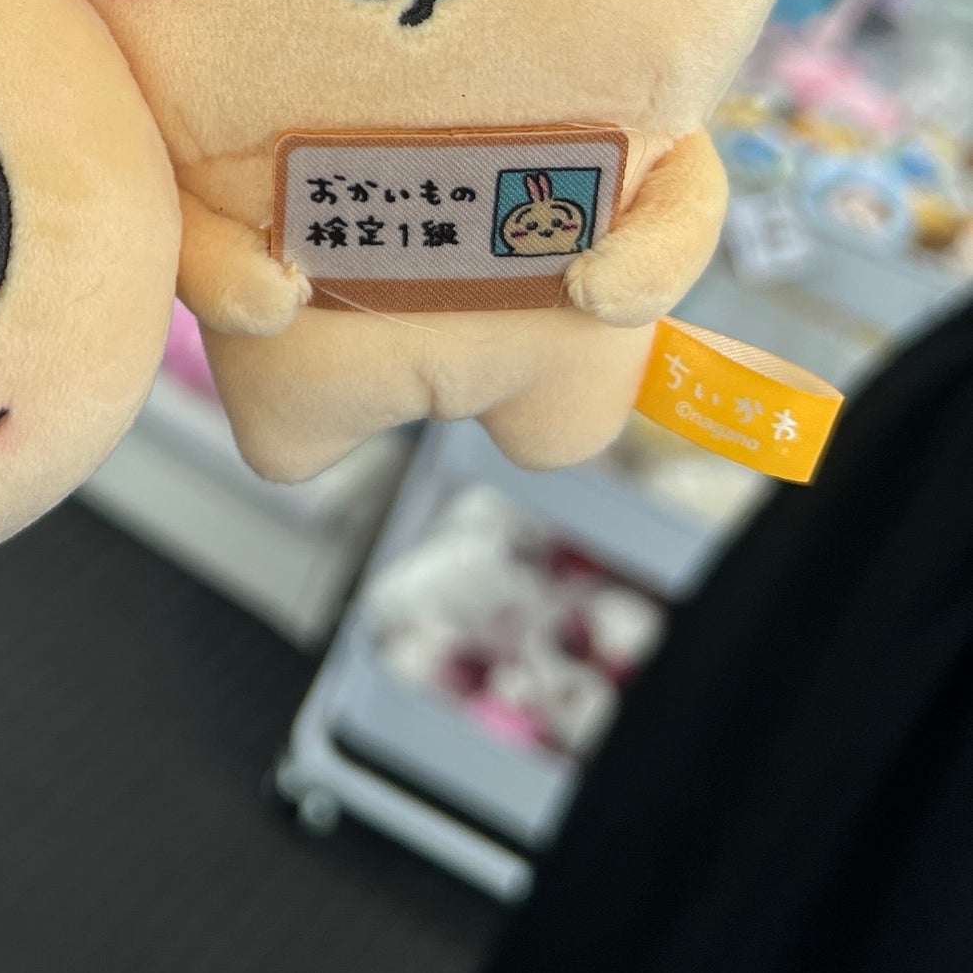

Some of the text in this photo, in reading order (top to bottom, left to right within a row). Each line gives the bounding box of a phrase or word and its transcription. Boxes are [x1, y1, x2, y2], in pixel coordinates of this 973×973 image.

[306, 174, 476, 206] おかいもの
[306, 215, 459, 248] 検定1級
[663, 352, 799, 442] ちいかわ
